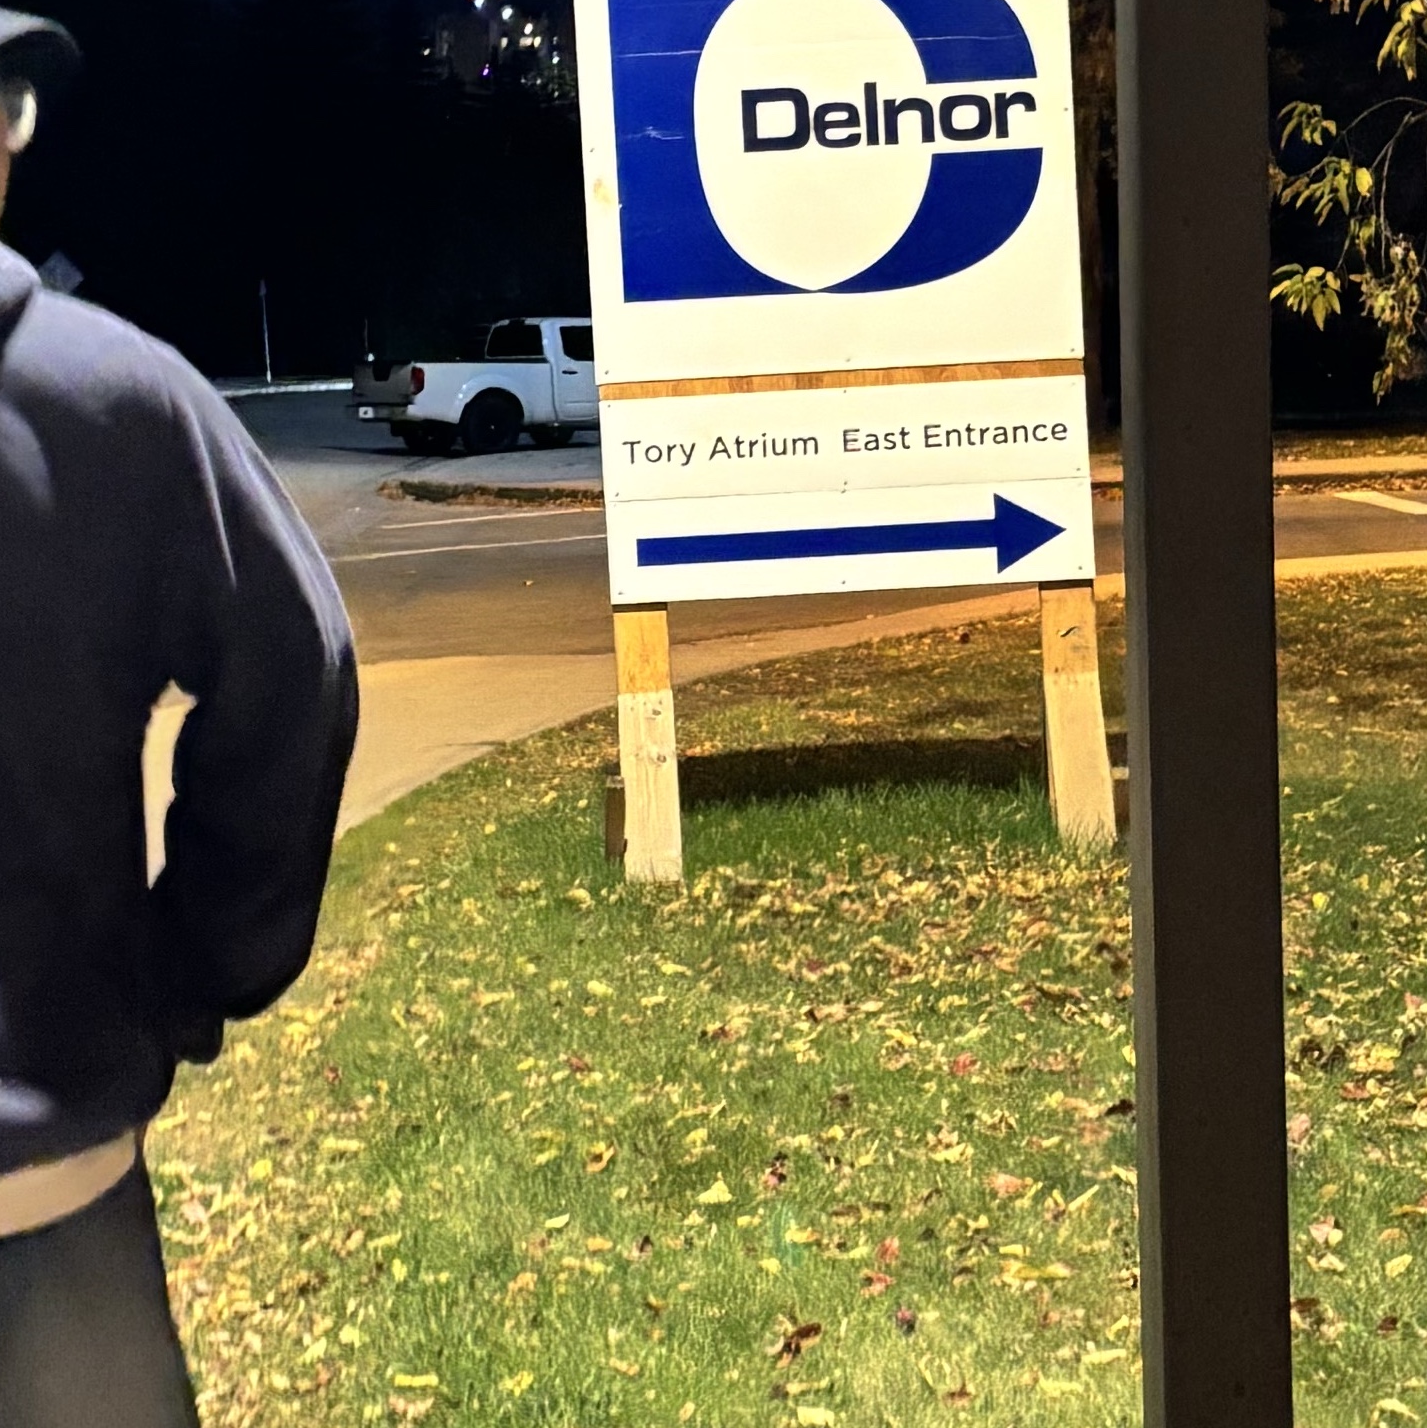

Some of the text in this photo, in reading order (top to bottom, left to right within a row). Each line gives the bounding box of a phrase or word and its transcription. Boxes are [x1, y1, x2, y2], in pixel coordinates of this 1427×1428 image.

[741, 81, 1037, 153] Delnor
[622, 422, 1068, 467] Tory Atrium East Entrance
